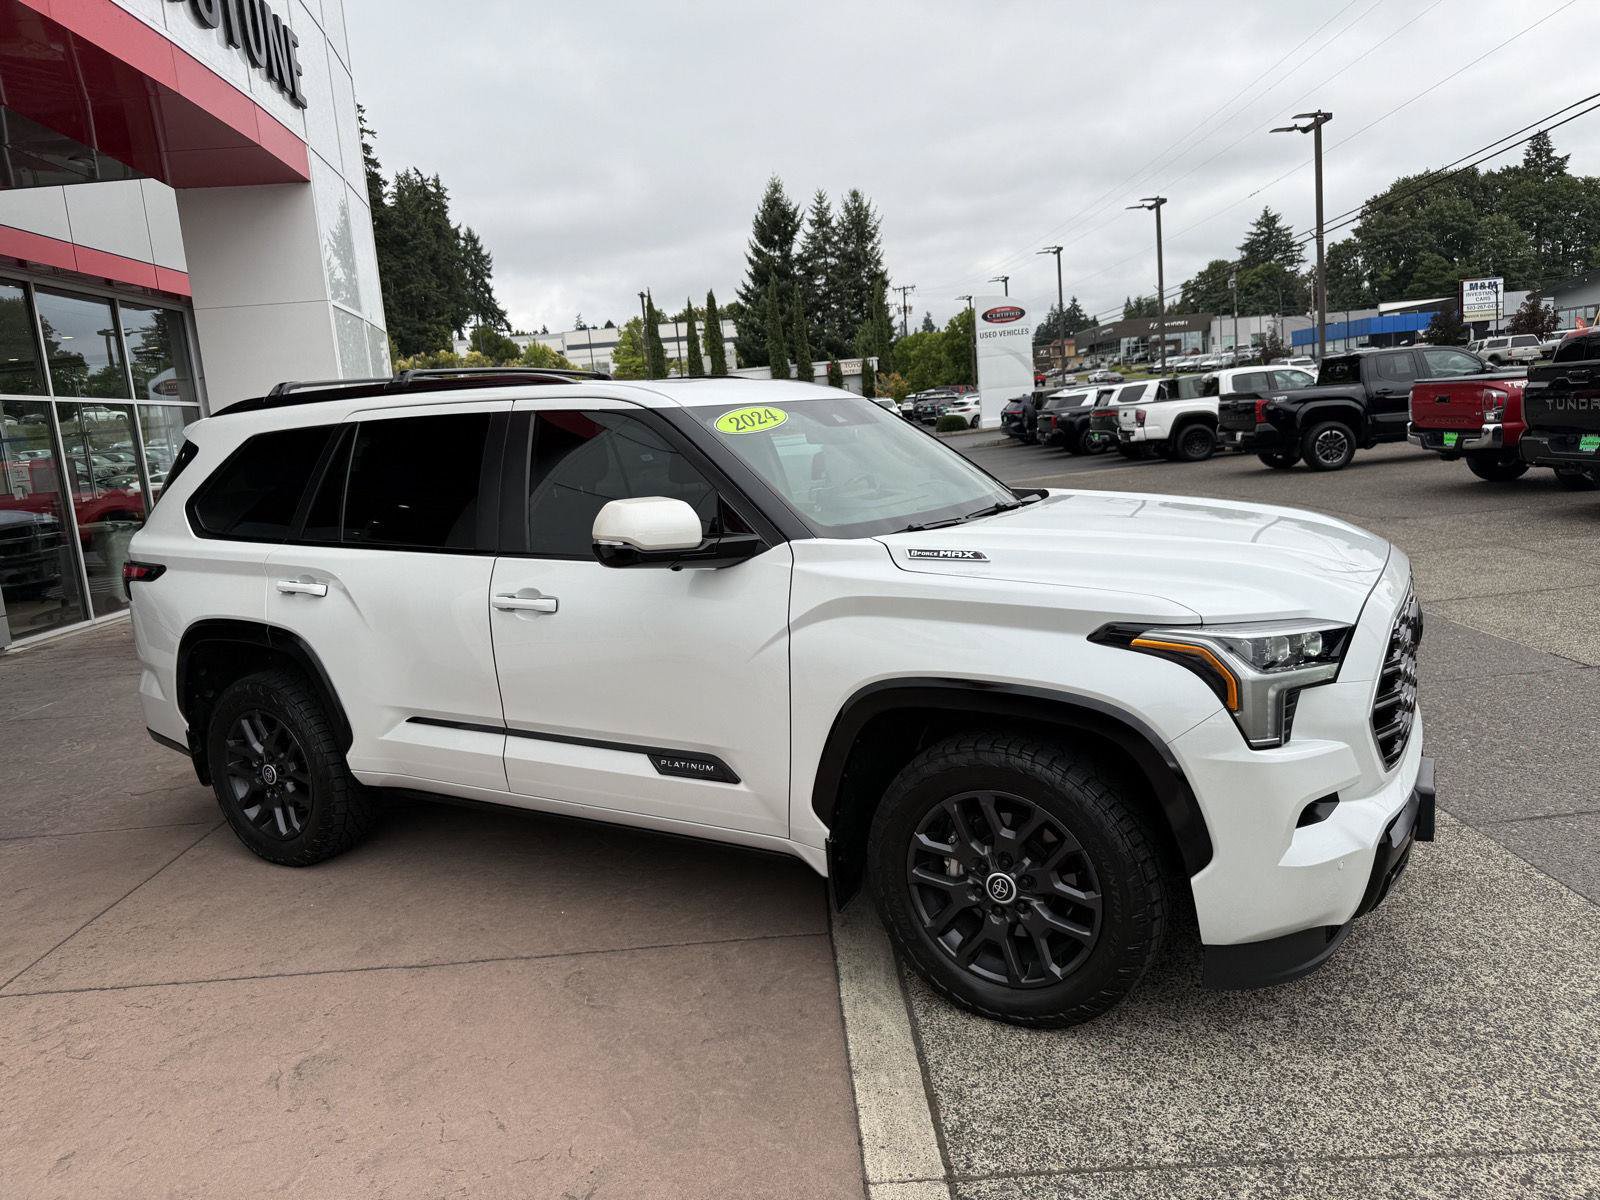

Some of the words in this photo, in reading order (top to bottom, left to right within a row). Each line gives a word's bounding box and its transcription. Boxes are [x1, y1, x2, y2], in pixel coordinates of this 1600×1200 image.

[980, 331, 997, 339] USED
[998, 328, 1029, 337] VEHICLES
[728, 408, 779, 432] 2024
[940, 550, 976, 558] MAX
[660, 759, 714, 772] PLATINUM
